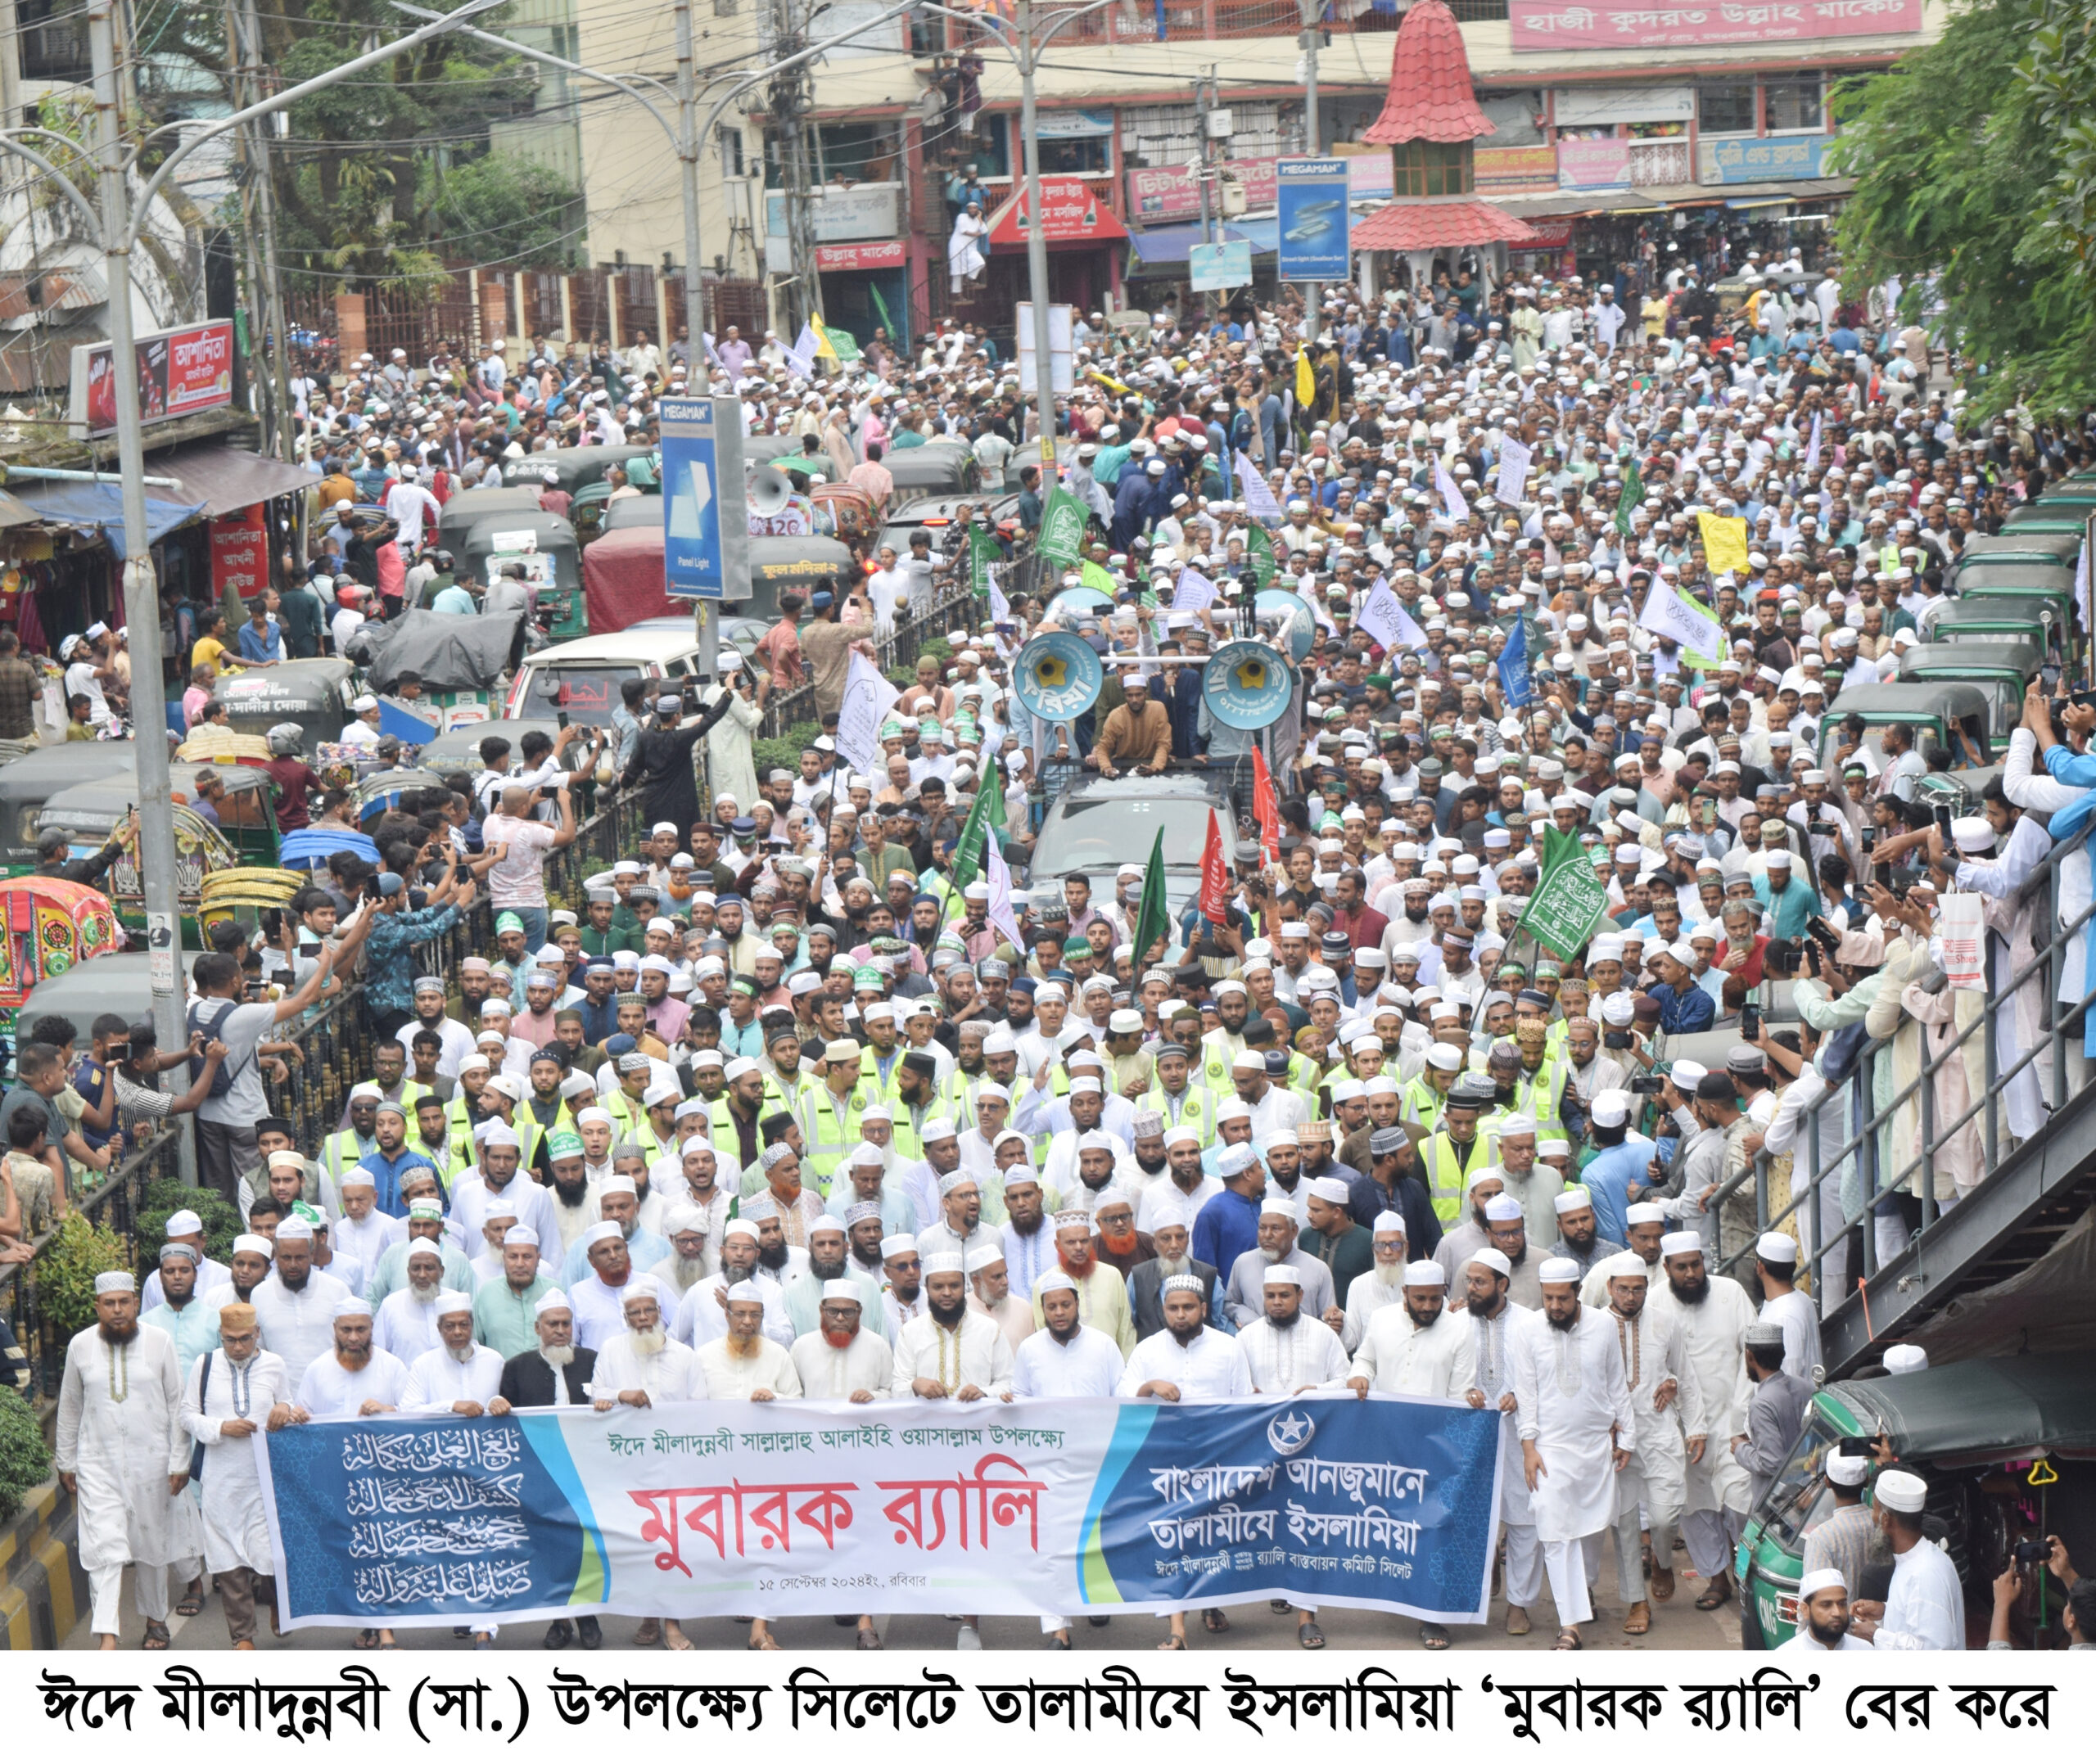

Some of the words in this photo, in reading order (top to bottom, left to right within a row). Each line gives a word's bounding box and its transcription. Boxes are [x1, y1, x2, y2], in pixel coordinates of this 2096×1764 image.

[1520, 7, 1597, 31] হাজী
[1606, 9, 1711, 33] কুদরত
[1719, 3, 1805, 25] উল্লাহ
[1281, 163, 1338, 174] MEGAMAN
[821, 248, 858, 262] উল্লাহ
[861, 243, 902, 259] মার্কেট
[174, 331, 226, 367] আশানিতা
[664, 405, 705, 420] MEGAMAN
[214, 528, 262, 545] আশানিতা
[223, 548, 255, 566] আখনী
[678, 556, 693, 567] Panel
[694, 557, 710, 571] Light
[224, 697, 271, 714] া-দাদীর
[273, 699, 308, 712] দোয়া
[608, 1432, 644, 1456] ঈদে
[653, 1426, 735, 1458] মীলাদুন্নবী
[740, 1428, 814, 1456] সাল্লাল্লাহু
[819, 1424, 893, 1450] আলাইহি
[900, 1426, 983, 1449] ওয়াসাল্লাম
[988, 1423, 1065, 1449] উপলক্ষ্যে
[1149, 1461, 1280, 1504] বাংলাদেশ
[1285, 1455, 1429, 1505] আনজুমানে
[626, 1476, 861, 1578] মুবারক
[1148, 1502, 1279, 1550] তালামীযে
[1285, 1498, 1422, 1556] ইসলামিয়া
[1154, 1559, 1179, 1578] ঈদে
[1181, 1550, 1231, 1576] মীলাদুন্নবী
[1289, 1552, 1338, 1572] বাস্তবায়ন
[1341, 1554, 1376, 1575] কমিটি
[1379, 1556, 1413, 1580] সিলেট
[758, 1578, 775, 1591] ১৫
[779, 1574, 827, 1591] সেপ্টেম্বর
[889, 1572, 927, 1589] রবিবার
[1759, 1595, 1778, 1635] CNG
